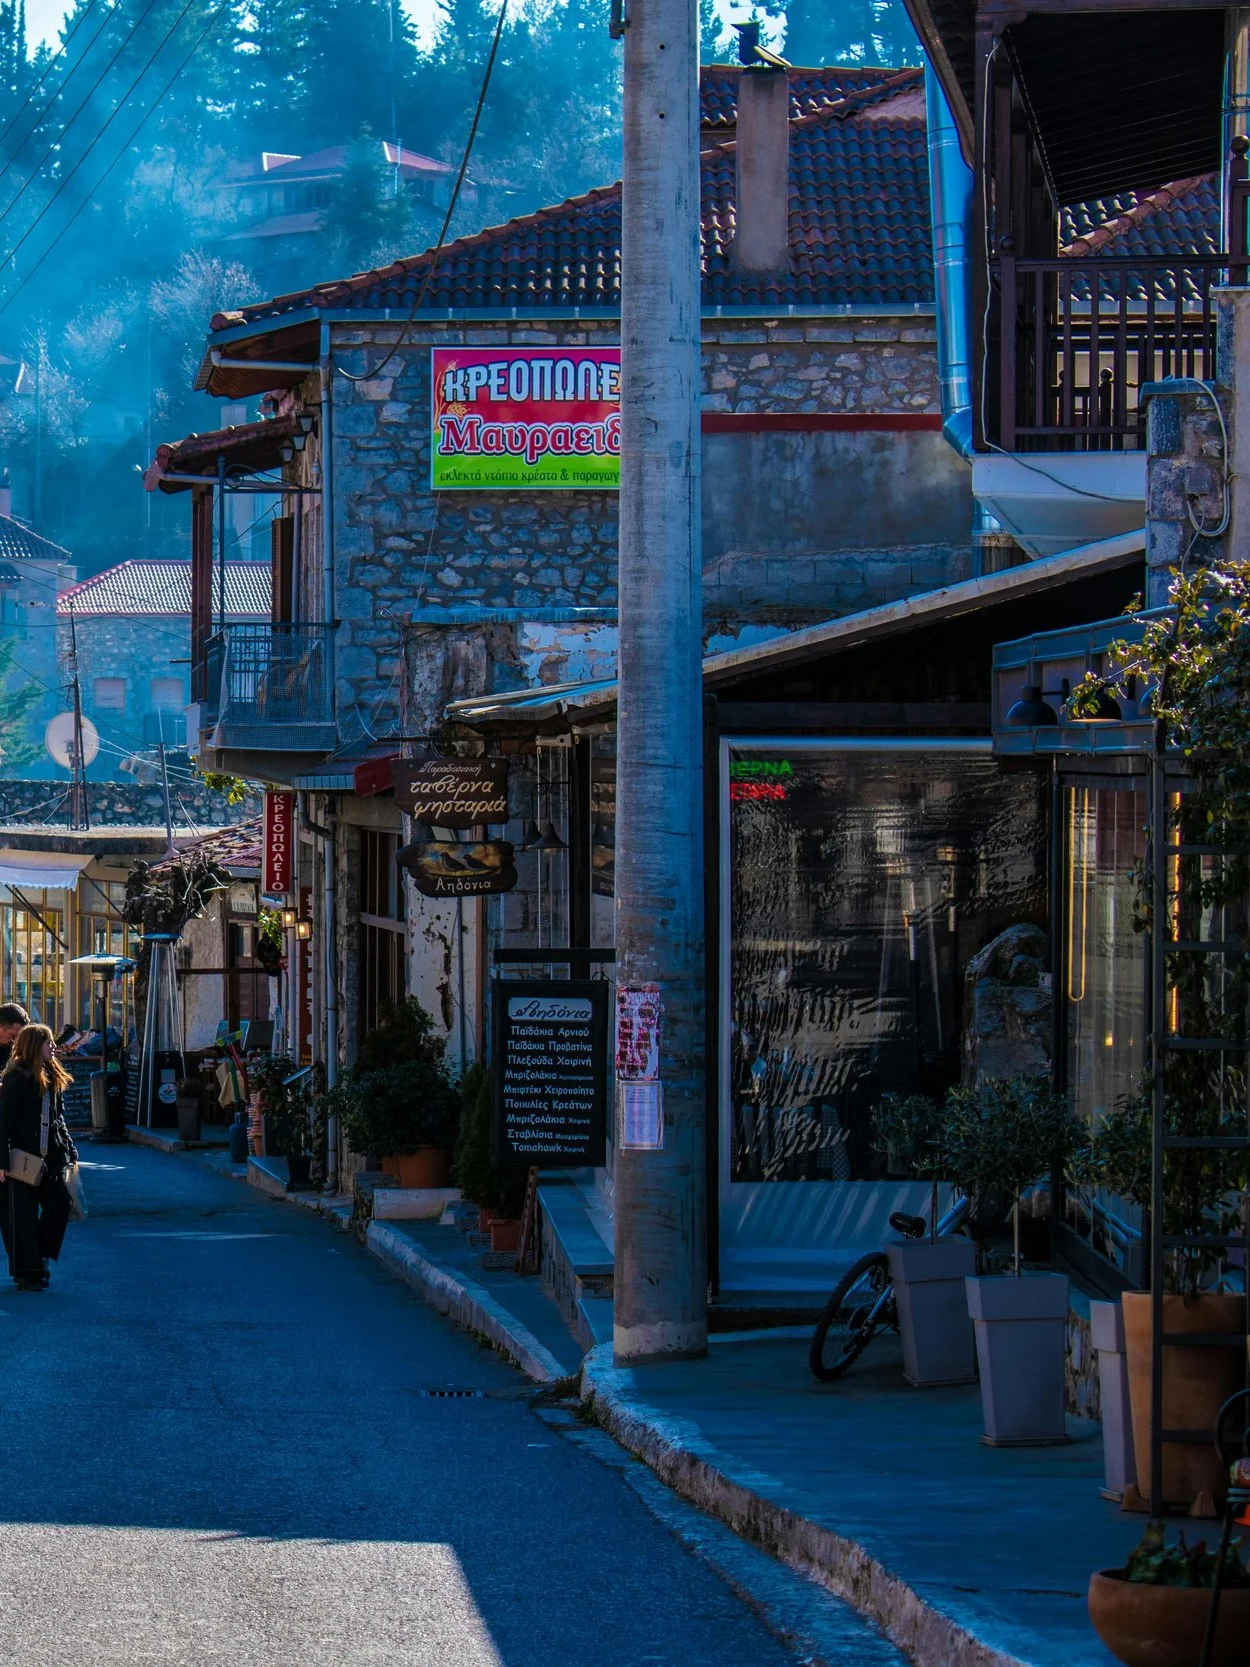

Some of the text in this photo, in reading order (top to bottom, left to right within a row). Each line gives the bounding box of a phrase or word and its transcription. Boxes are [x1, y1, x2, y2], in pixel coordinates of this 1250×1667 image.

[443, 357, 621, 402] ΚΡΕΟΠΩΛΕ
[440, 416, 621, 464] Μαυραειδ
[440, 468, 619, 483] εκλεκτά ντόπια κρέατα & παραγωγ
[410, 774, 494, 800] ταβέρνα
[414, 796, 507, 820] ψησταριά
[271, 794, 286, 891] ΚΡΕΟΠΩΛΕΙΟ
[435, 877, 491, 893] Αηδόνια
[511, 1026, 589, 1037] Παϊδάκια Αρνιού
[507, 1041, 592, 1052] Παϊδάκια Προβατίνα
[507, 1055, 592, 1067] Πλεξούδα Χοιρινή
[505, 1069, 557, 1081] Μπριζολάκια
[504, 1084, 594, 1096] Μπιφτέκι Χειροποίητο
[505, 1099, 592, 1110] Ποικιλίες Κρεάτων
[506, 1114, 565, 1125] Μπριζολάκια
[512, 1142, 561, 1152] Tomahawk
